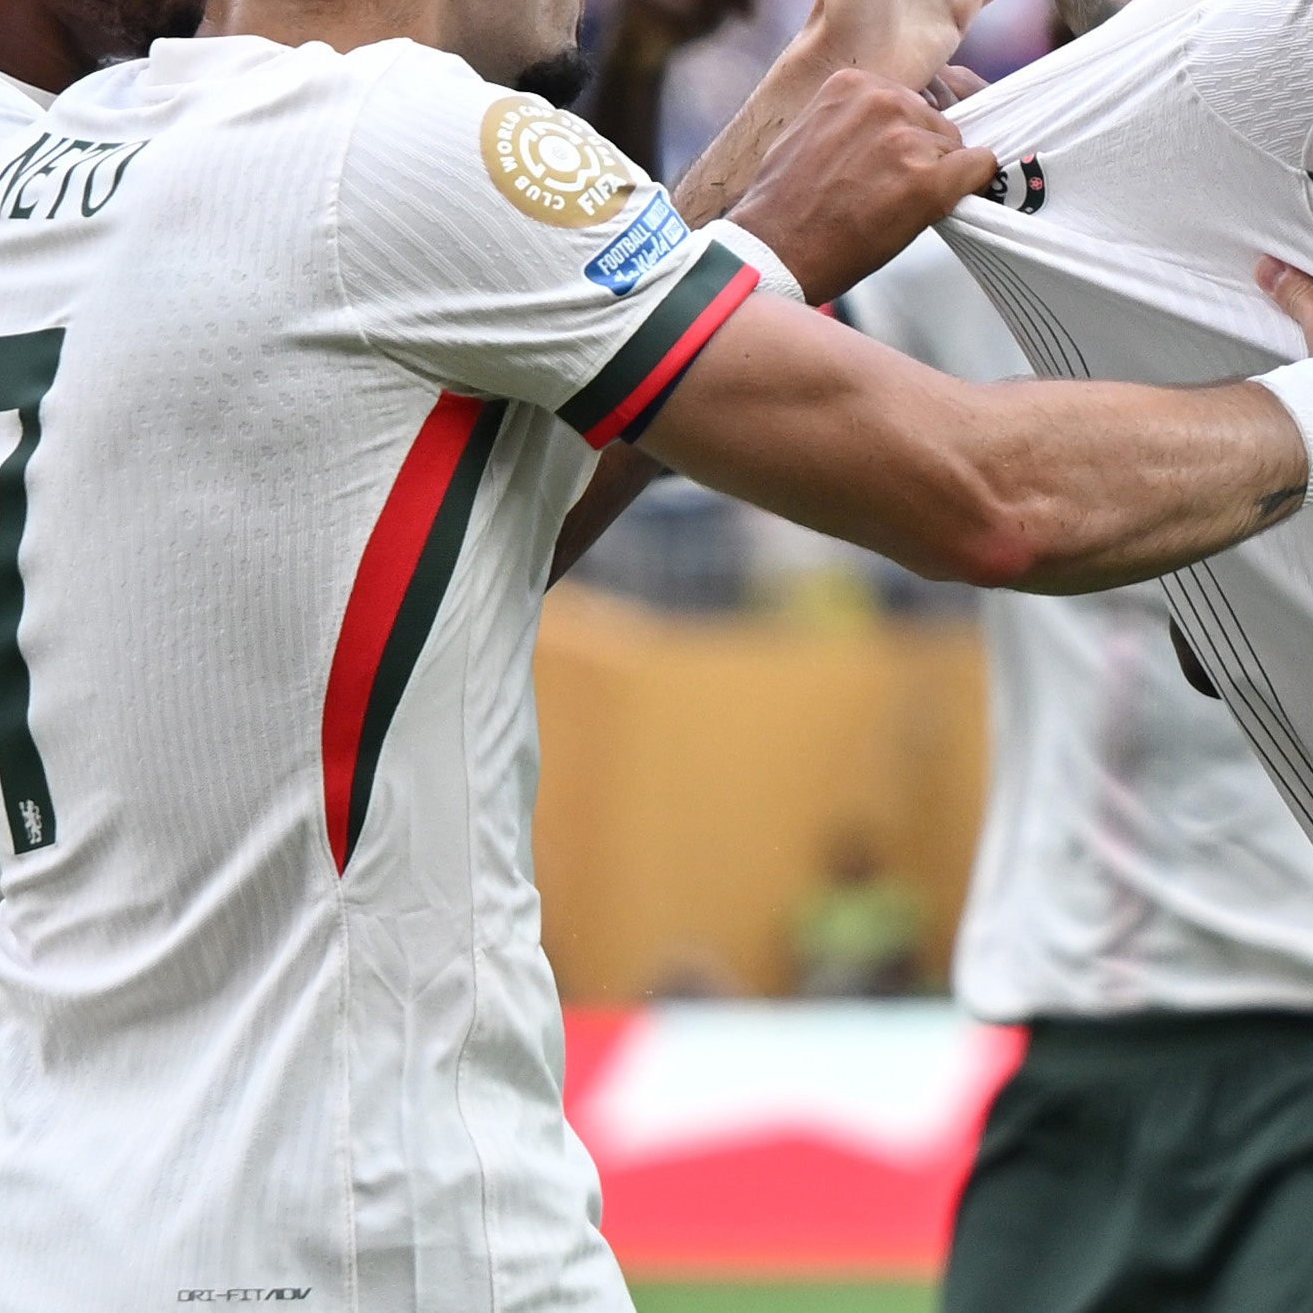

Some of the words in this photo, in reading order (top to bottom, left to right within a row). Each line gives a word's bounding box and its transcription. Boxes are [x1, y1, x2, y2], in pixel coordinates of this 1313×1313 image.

[497, 111, 521, 173] WORLD
[514, 175, 565, 210] CLUB
[577, 173, 627, 216] FIFA
[597, 223, 652, 276] FOOTBALL
